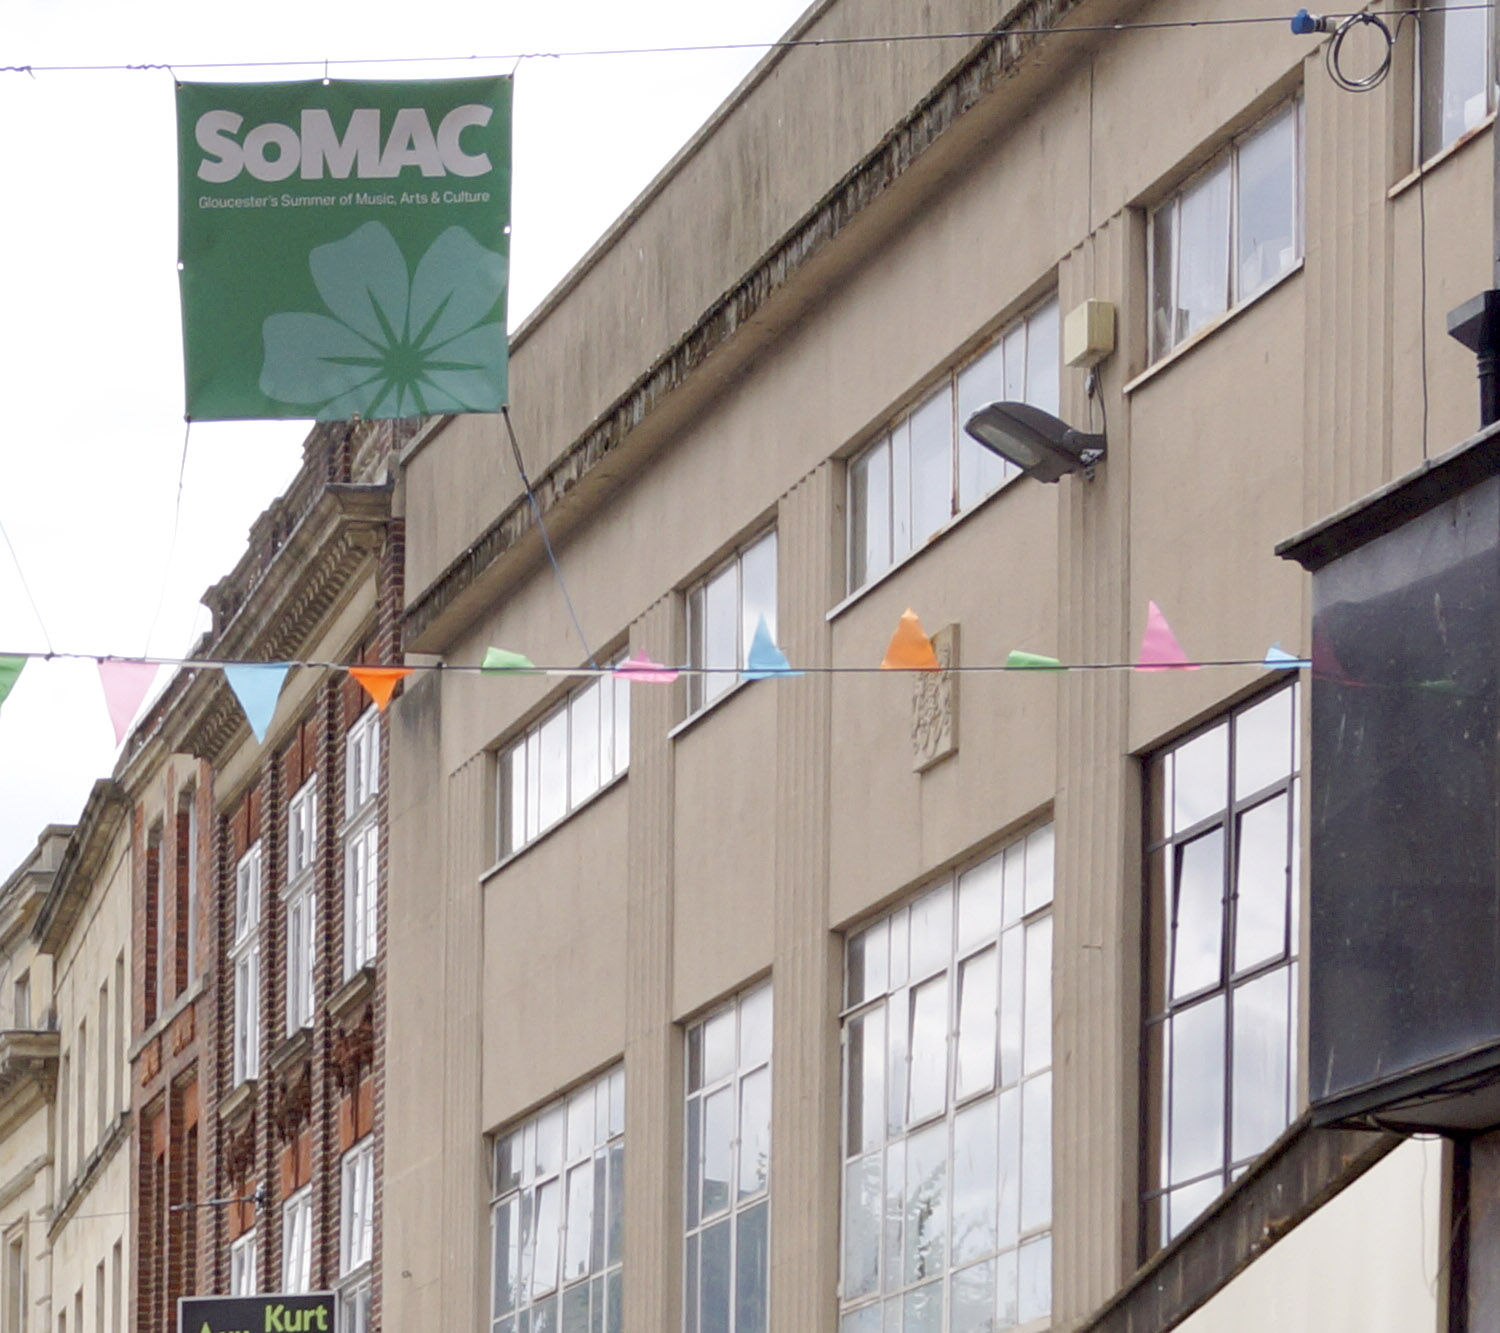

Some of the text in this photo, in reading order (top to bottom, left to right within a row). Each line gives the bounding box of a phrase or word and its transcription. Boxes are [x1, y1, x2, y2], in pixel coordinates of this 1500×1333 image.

[195, 103, 493, 183] SoMAC
[199, 189, 490, 209] Gloucester's Summer of Music, Arts & Culture
[265, 1304, 327, 1333] Kurt
